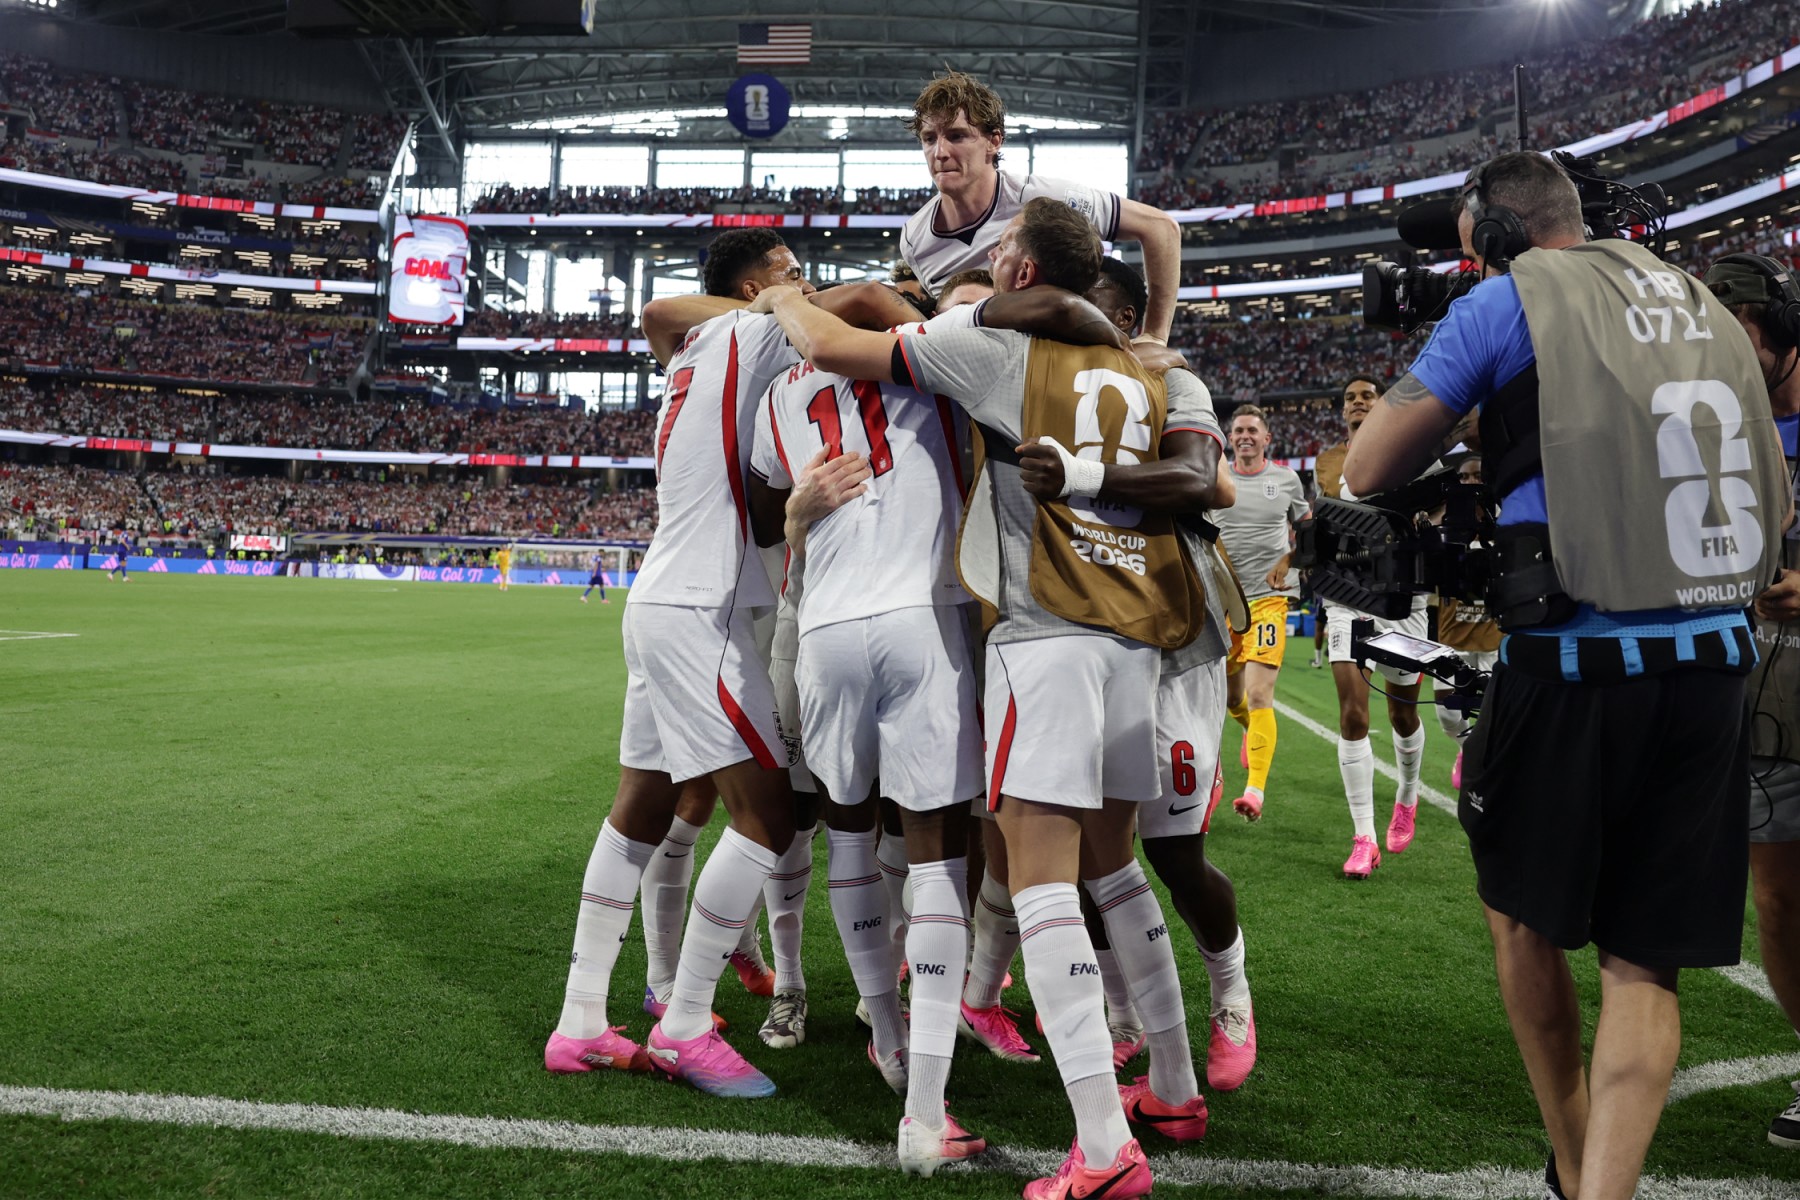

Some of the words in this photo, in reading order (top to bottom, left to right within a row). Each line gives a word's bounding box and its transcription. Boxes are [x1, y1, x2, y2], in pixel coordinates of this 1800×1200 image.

[176, 231, 231, 244] DALLAS
[404, 257, 452, 280] GOAL
[1624, 268, 1685, 300] HB
[806, 379, 893, 478] 11
[1072, 522, 1116, 545] WORLD
[1117, 535, 1147, 551] CUP
[1701, 535, 1739, 558] FIFA
[224, 561, 249, 575] You
[1070, 539, 1147, 576] 2026
[1676, 583, 1738, 606] WORLD
[1257, 624, 1276, 647] 13
[1170, 740, 1196, 796] 6
[853, 916, 882, 931] ENG
[1146, 923, 1169, 942] ENG
[916, 963, 946, 976] ENG
[1070, 963, 1099, 976] ENG
